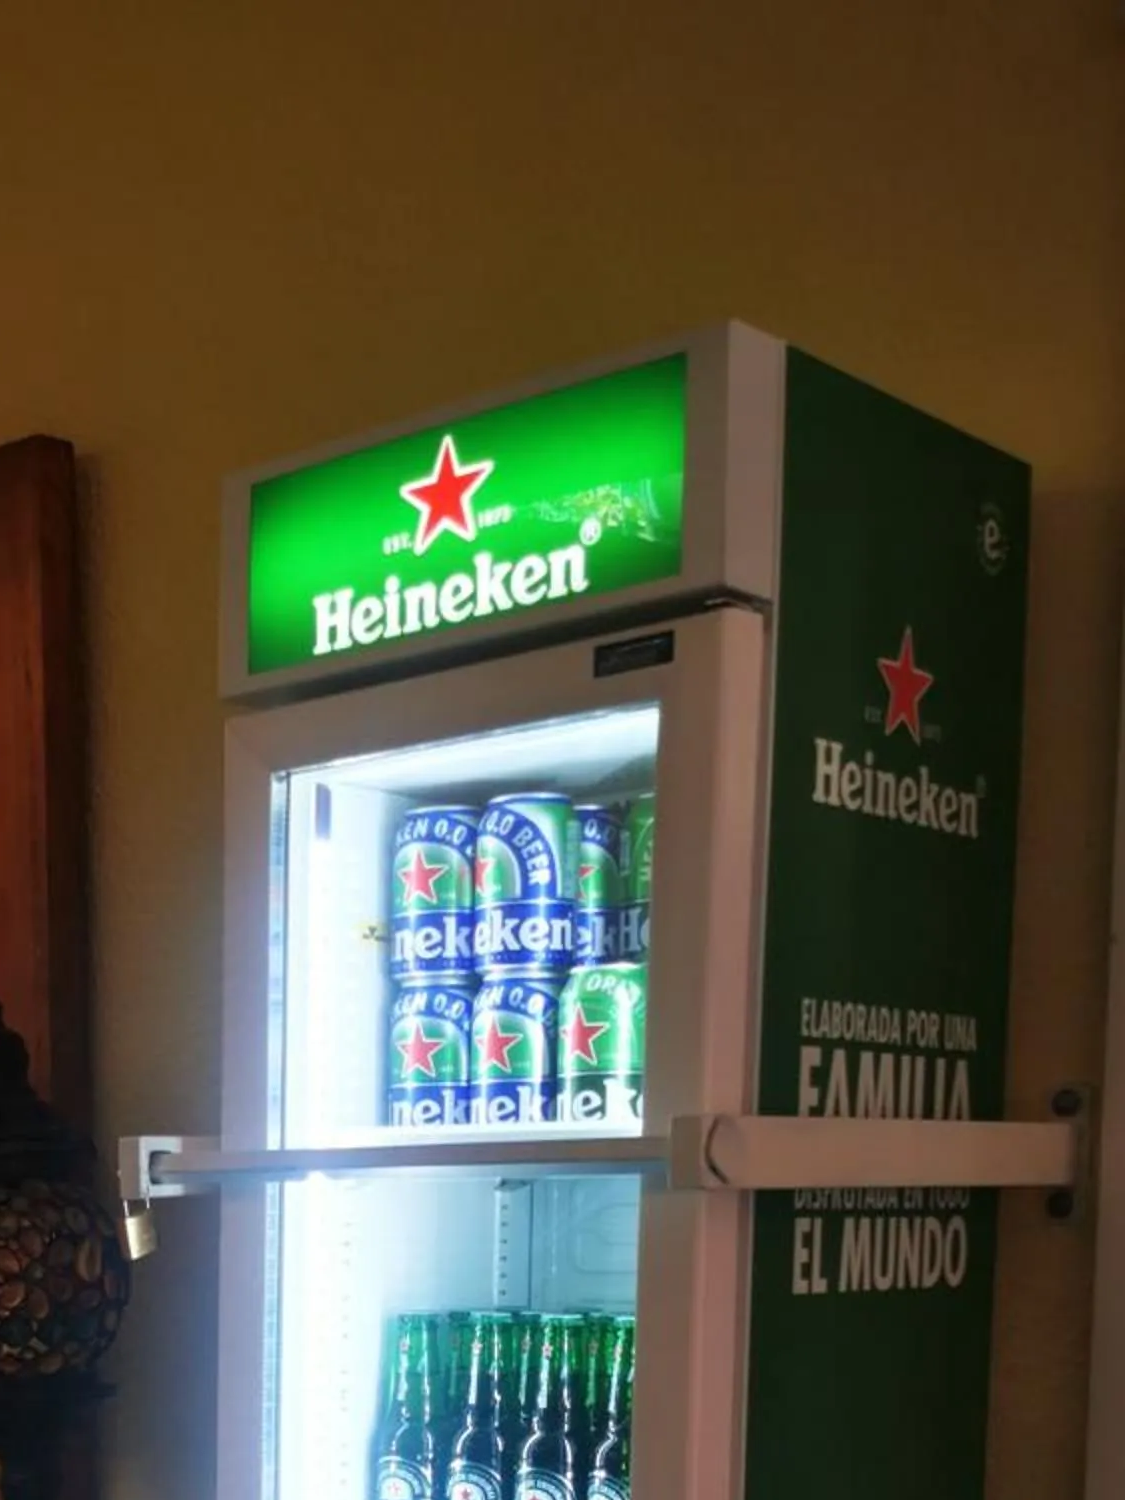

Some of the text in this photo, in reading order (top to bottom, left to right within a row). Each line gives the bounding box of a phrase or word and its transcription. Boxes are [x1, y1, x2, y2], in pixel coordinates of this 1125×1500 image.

[312, 544, 590, 655] Heineken
[812, 736, 979, 839] Heineken
[433, 818, 468, 846] 0.0
[512, 827, 552, 886] BEER
[432, 993, 467, 1020] 0.0
[801, 997, 977, 1052] ELABORADA POR UNA
[792, 1214, 968, 1295] EL MUNDO
